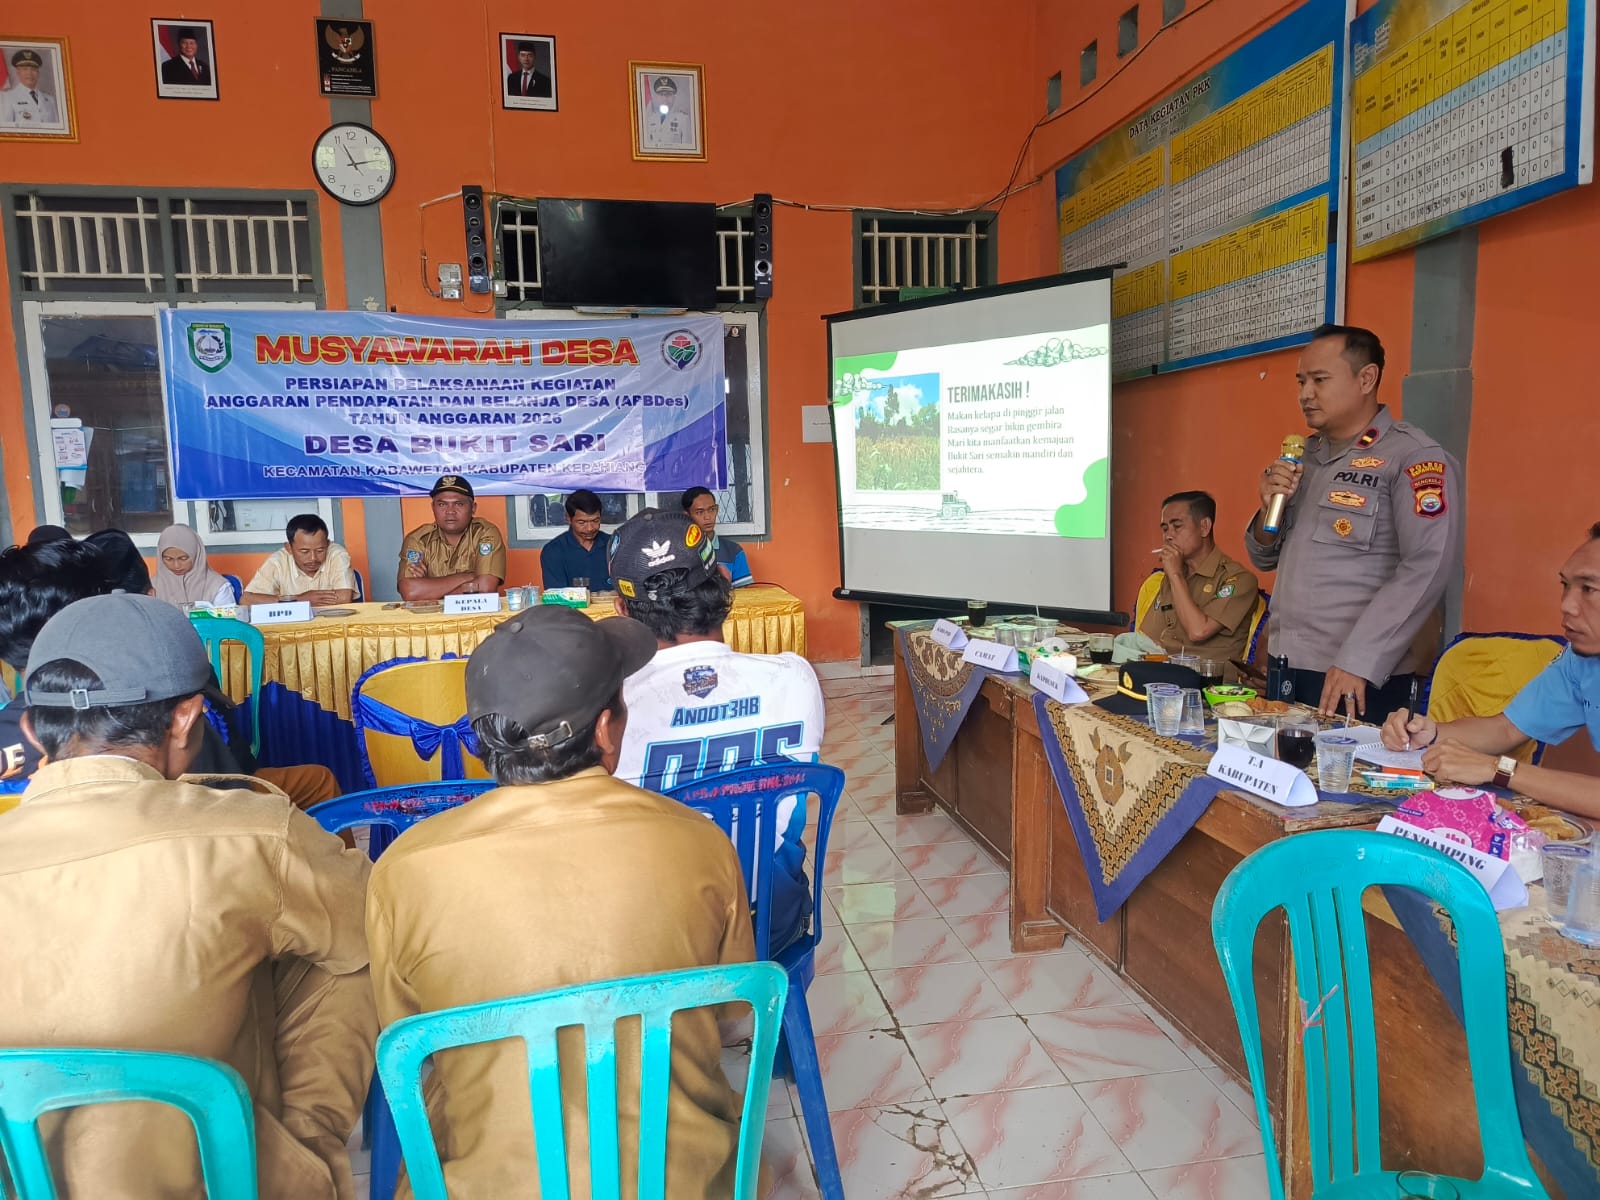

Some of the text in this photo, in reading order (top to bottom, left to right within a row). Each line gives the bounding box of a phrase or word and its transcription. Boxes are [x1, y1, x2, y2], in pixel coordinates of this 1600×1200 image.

[1129, 120, 1149, 139] DATA
[1150, 90, 1191, 125] KEGIATAN
[1192, 77, 1211, 98] PKK
[335, 135, 340, 144] 11
[346, 131, 356, 140] 12
[364, 136, 368, 144] 1
[374, 147, 381, 155] 2
[328, 175, 336, 183] 8
[340, 185, 346, 193] 7
[354, 189, 361, 197] 6
[368, 185, 376, 194] 5
[256, 334, 532, 365] MUSYAWARAH
[541, 337, 640, 366] DESA
[285, 377, 616, 391] PERSIAPAN PELAKSANAAN KEGIATAN
[947, 381, 1023, 403] TERIMAKASIH
[206, 395, 690, 410] ANGGARAN PENDAPATAN DAN BELANJA DESA (APBDes)
[350, 412, 562, 425] TAHUN ANGGARAN 2026
[947, 404, 1065, 420] Makan kelapa di pinggir jalan
[947, 420, 1062, 435] Rasanya segar bikin gembira
[304, 434, 607, 454] DESA BUKIT SARI
[947, 435, 1075, 447] Mari kita manfaatkan kemajuan
[969, 451, 984, 460] Sari
[985, 449, 1021, 460] semakin
[1022, 448, 1056, 459] mandiri
[1057, 448, 1073, 458] dan
[264, 461, 647, 478] KECAMATAN KABAWETAN KABUPATEN KEPAHIANG
[1333, 471, 1379, 487] POLRI
[1217, 763, 1278, 795] KABUPATEN
